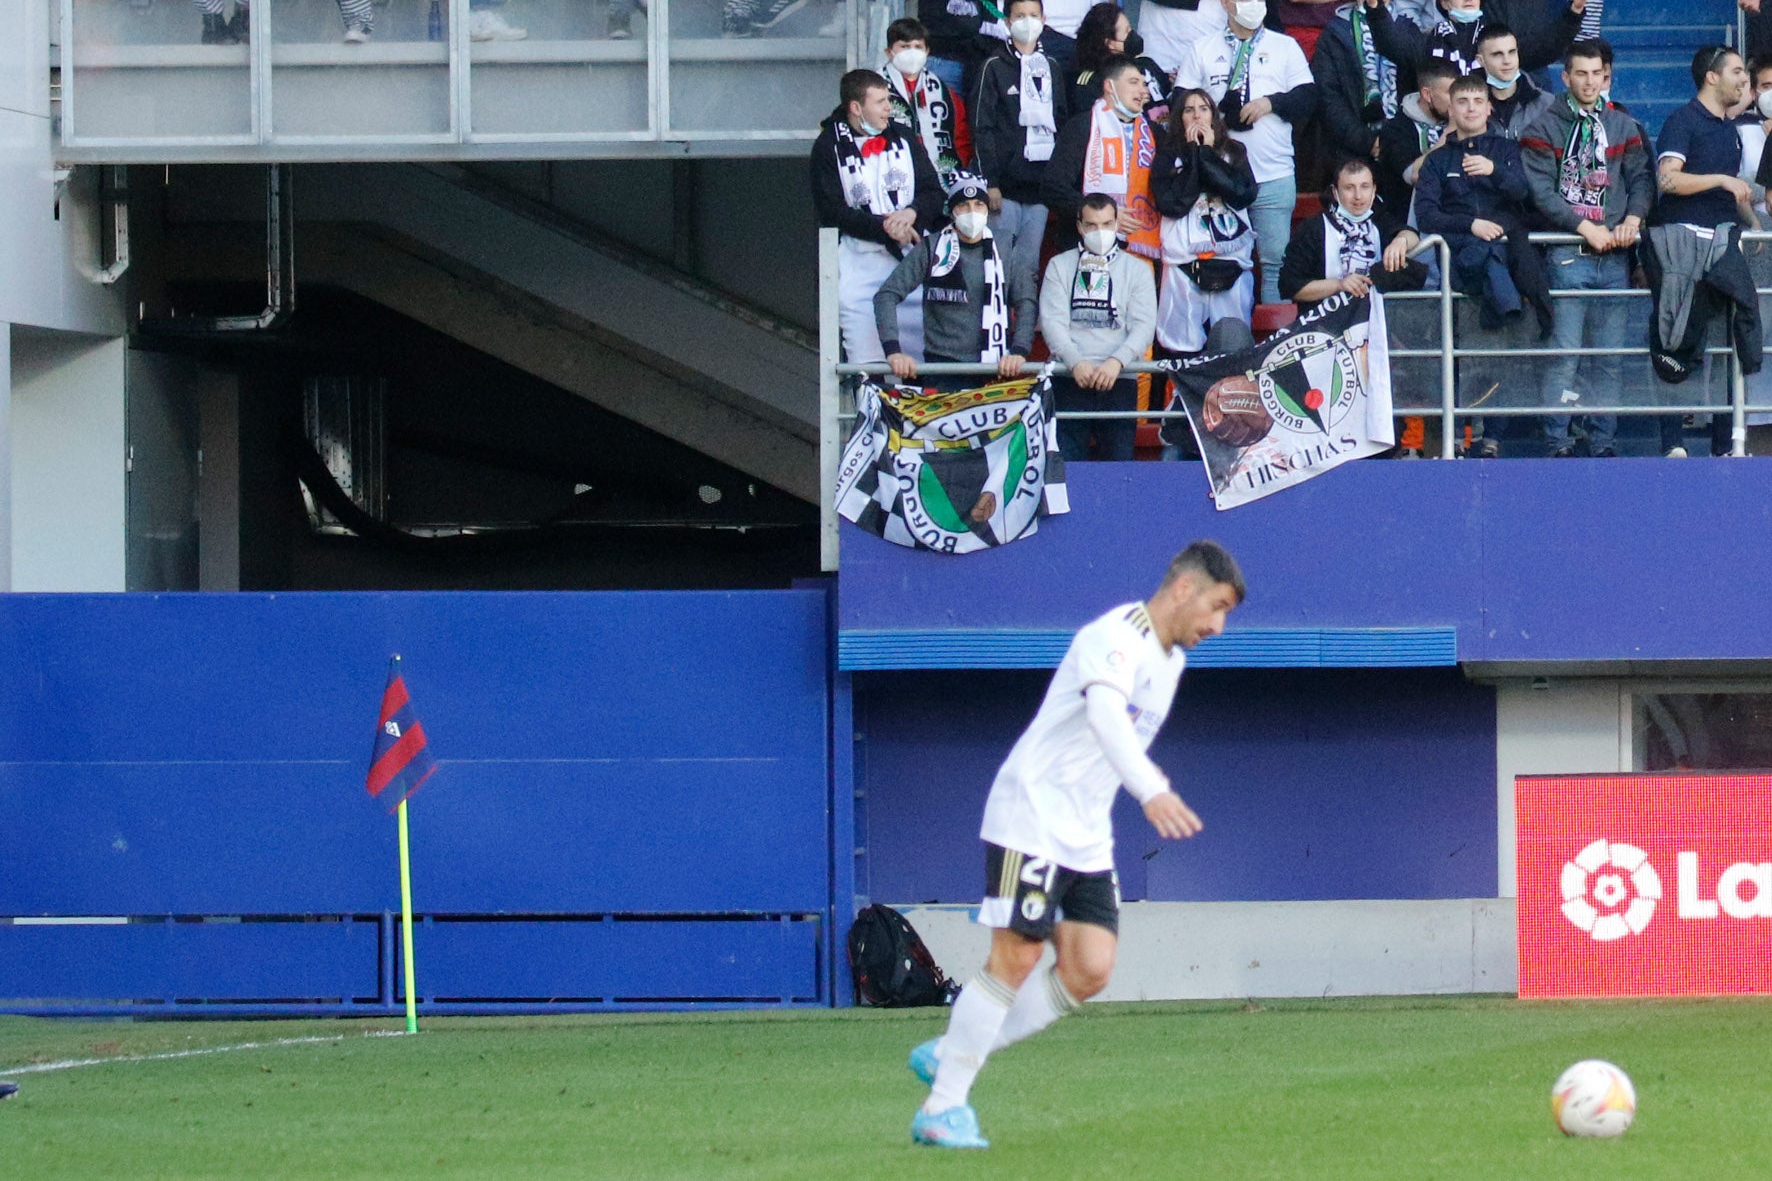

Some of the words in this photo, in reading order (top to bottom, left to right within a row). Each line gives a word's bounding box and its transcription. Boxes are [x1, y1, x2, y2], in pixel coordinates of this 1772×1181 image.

[1275, 333, 1317, 357] CLUB
[1259, 378, 1304, 430] BURGOS
[1335, 348, 1357, 410] FUTBOL
[937, 407, 1009, 440] CLUB
[1245, 434, 1358, 489] HINCHAS
